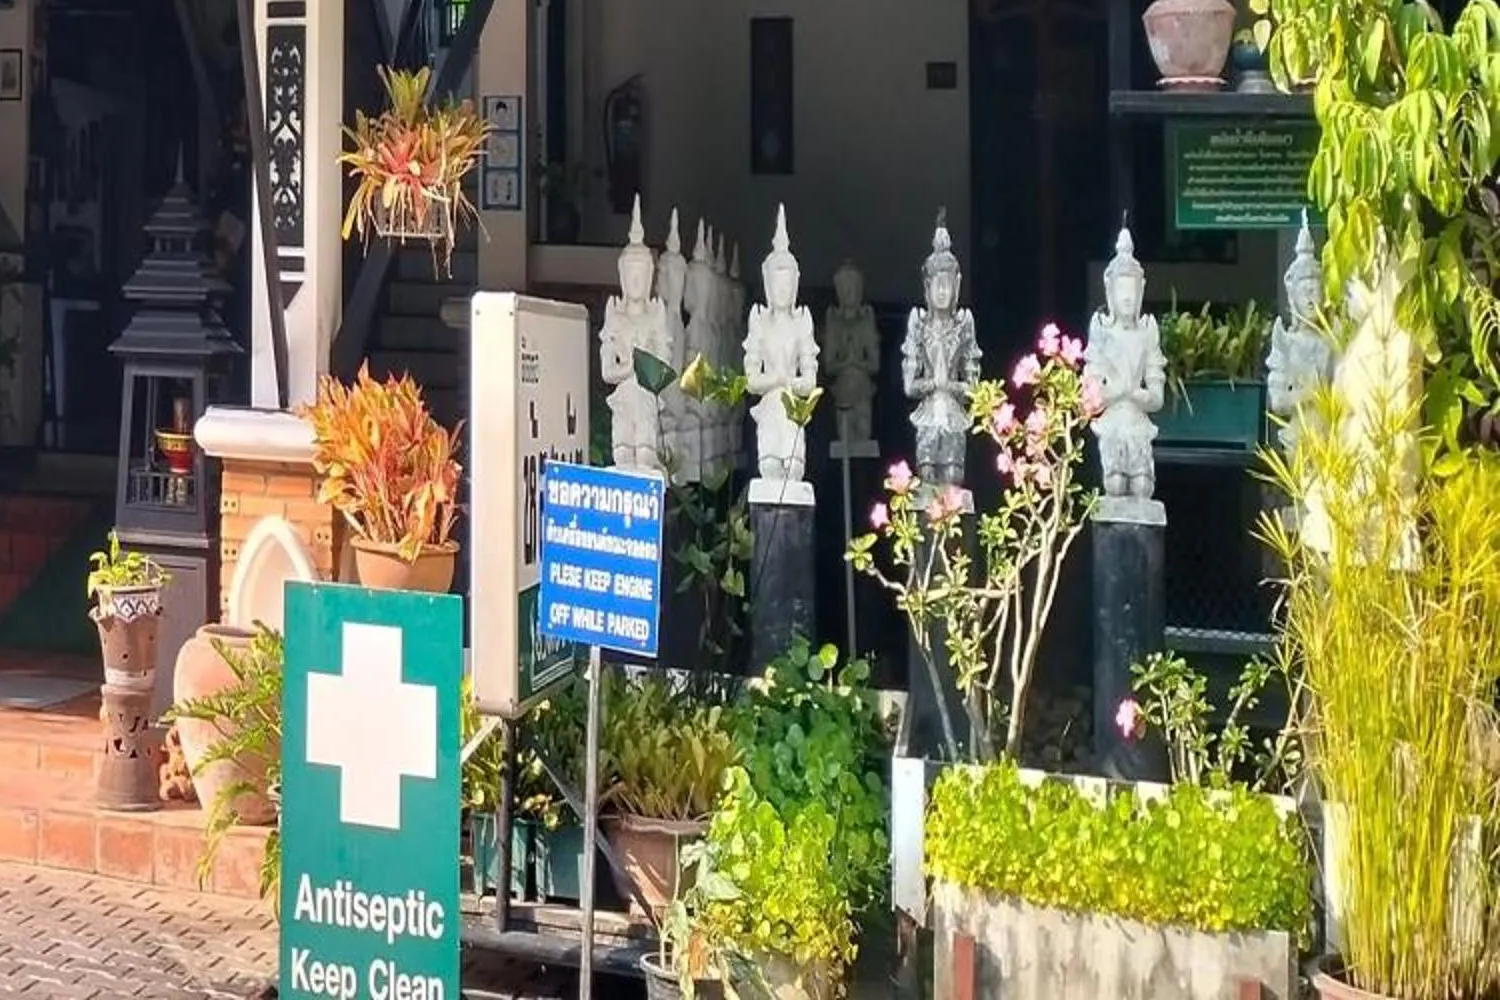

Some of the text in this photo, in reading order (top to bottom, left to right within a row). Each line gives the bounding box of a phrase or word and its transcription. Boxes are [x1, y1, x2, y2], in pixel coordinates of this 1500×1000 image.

[547, 478, 660, 530] ขอความกรุณา
[583, 567, 611, 593] KEEP
[613, 572, 653, 601] ENGINE
[550, 602, 650, 641] OFF WHILE PARKED
[294, 872, 445, 945] Antiseptic
[291, 947, 445, 1000] Keep Clean
